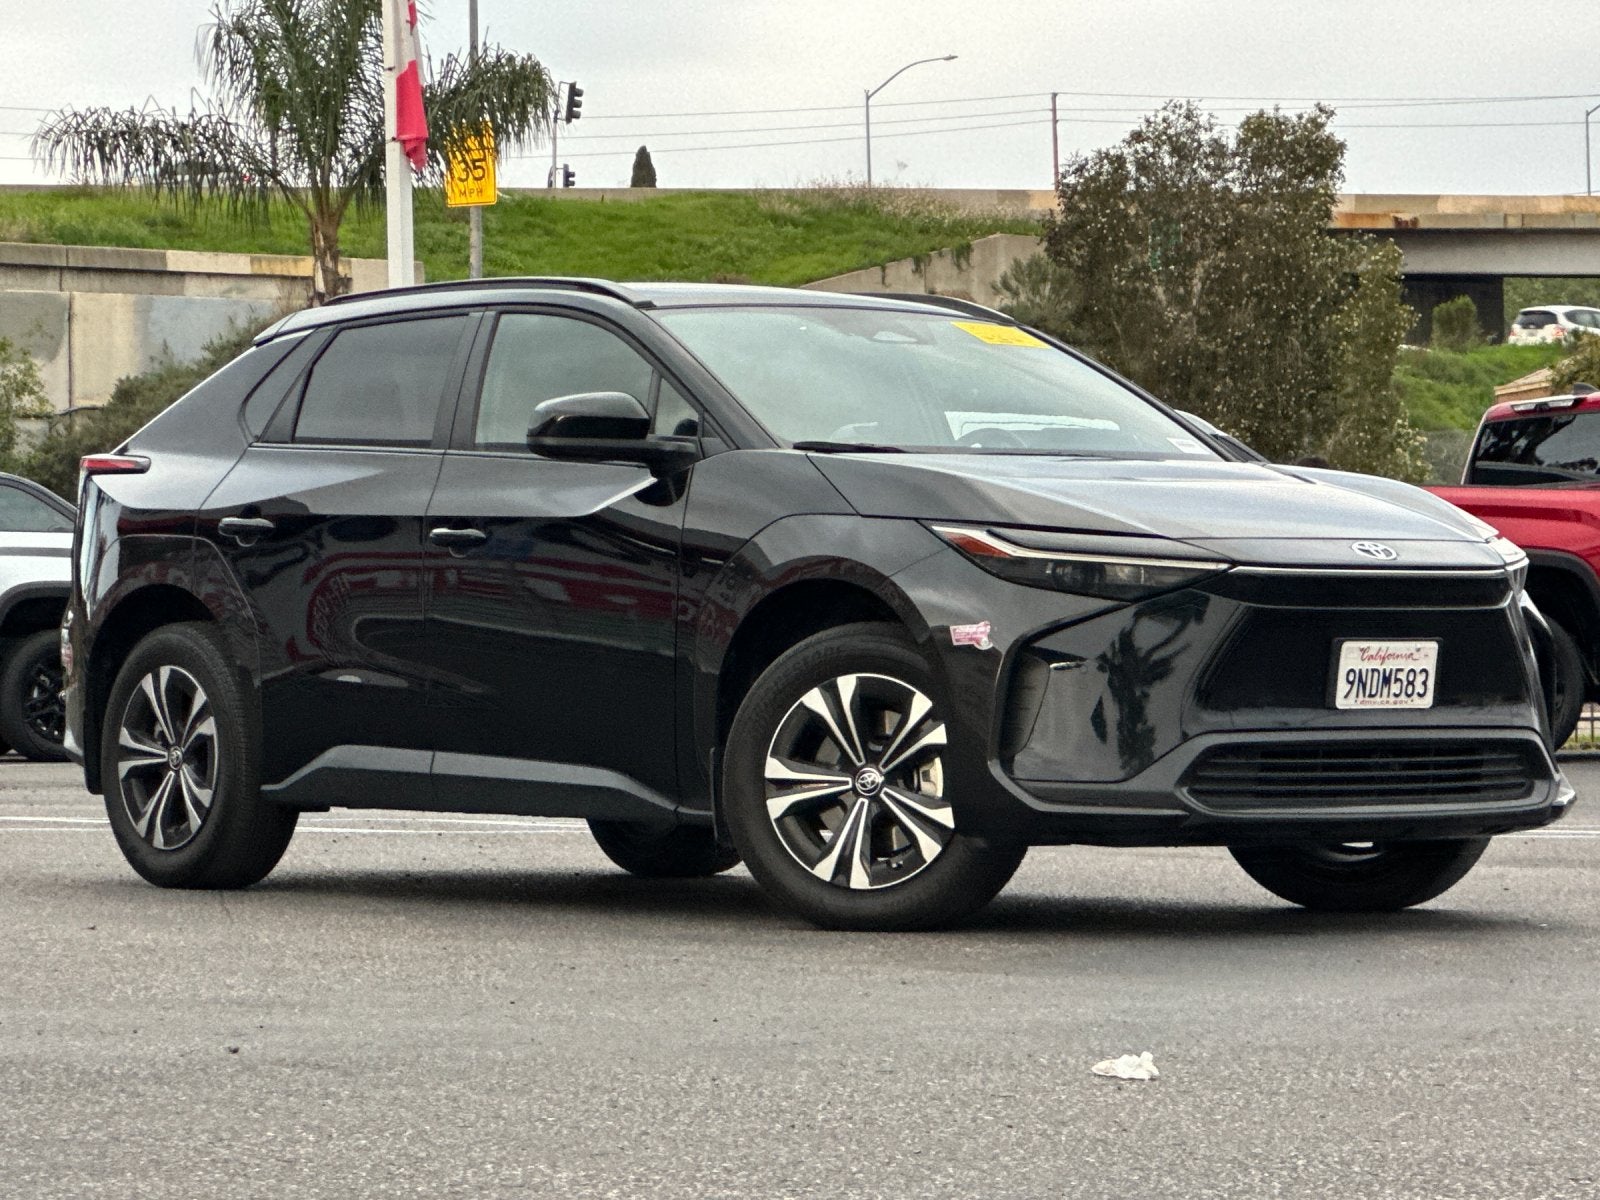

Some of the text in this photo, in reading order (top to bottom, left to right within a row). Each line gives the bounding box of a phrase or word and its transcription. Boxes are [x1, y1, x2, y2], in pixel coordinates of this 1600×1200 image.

[458, 156, 485, 182] 35
[459, 188, 483, 197] MPH
[1360, 646, 1419, 665] California
[1344, 668, 1429, 698] 9NDM583
